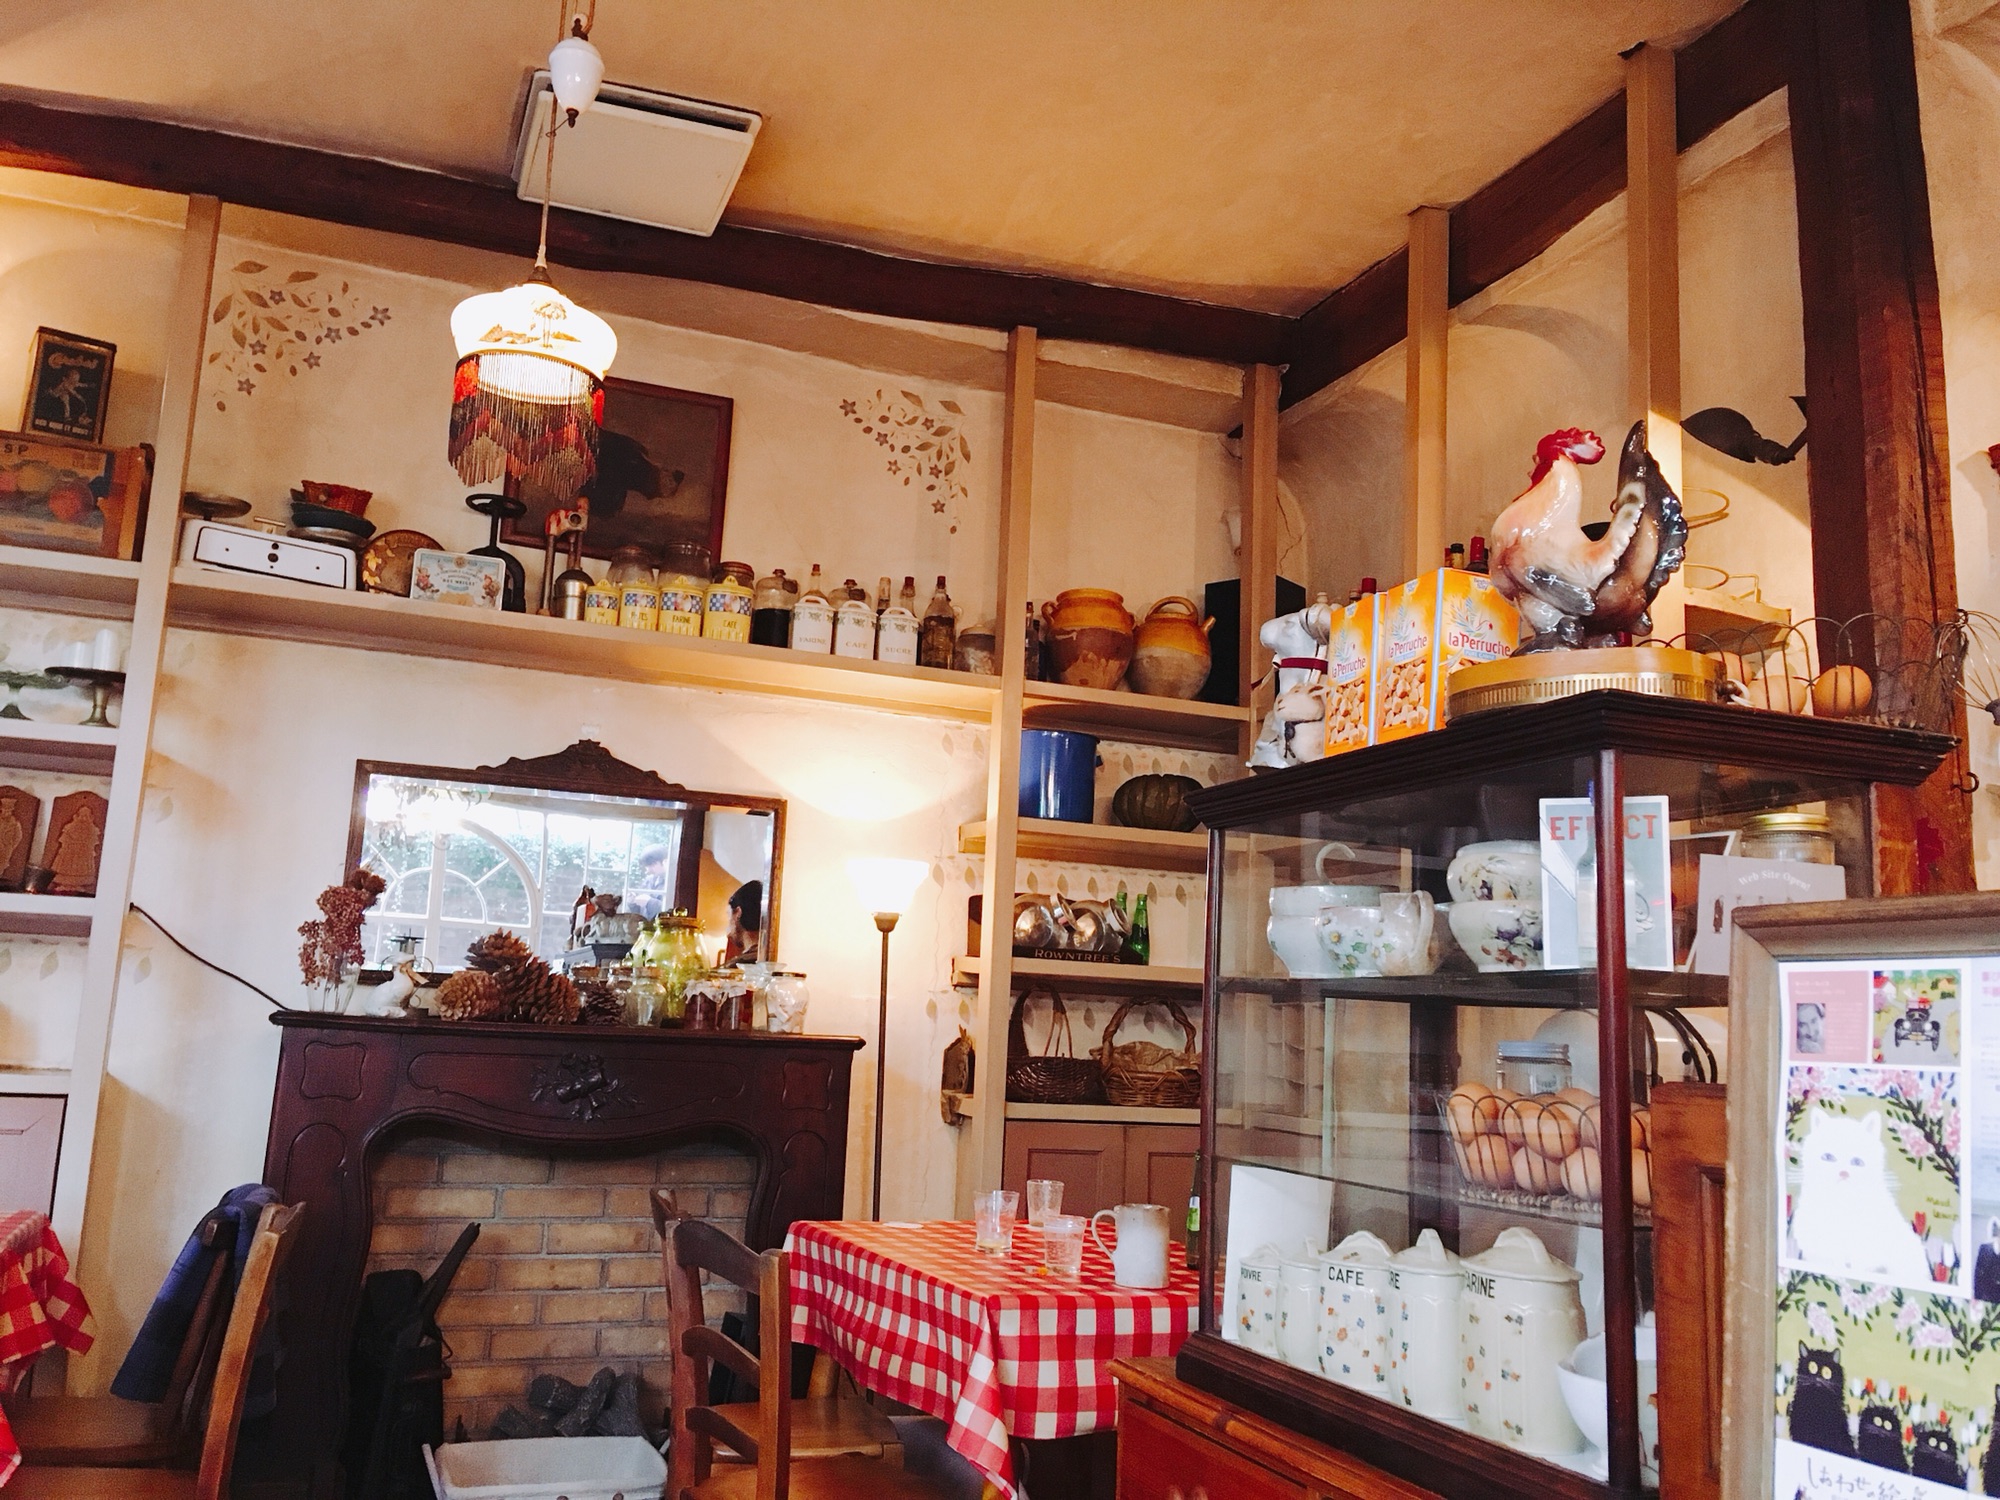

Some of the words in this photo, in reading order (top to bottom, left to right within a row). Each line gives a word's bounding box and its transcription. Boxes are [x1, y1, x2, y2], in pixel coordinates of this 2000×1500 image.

[1549, 814, 1657, 841] EFCT
[1738, 872, 1759, 886] Web
[1762, 869, 1780, 880] Site
[1328, 1266, 1365, 1287] CAFE
